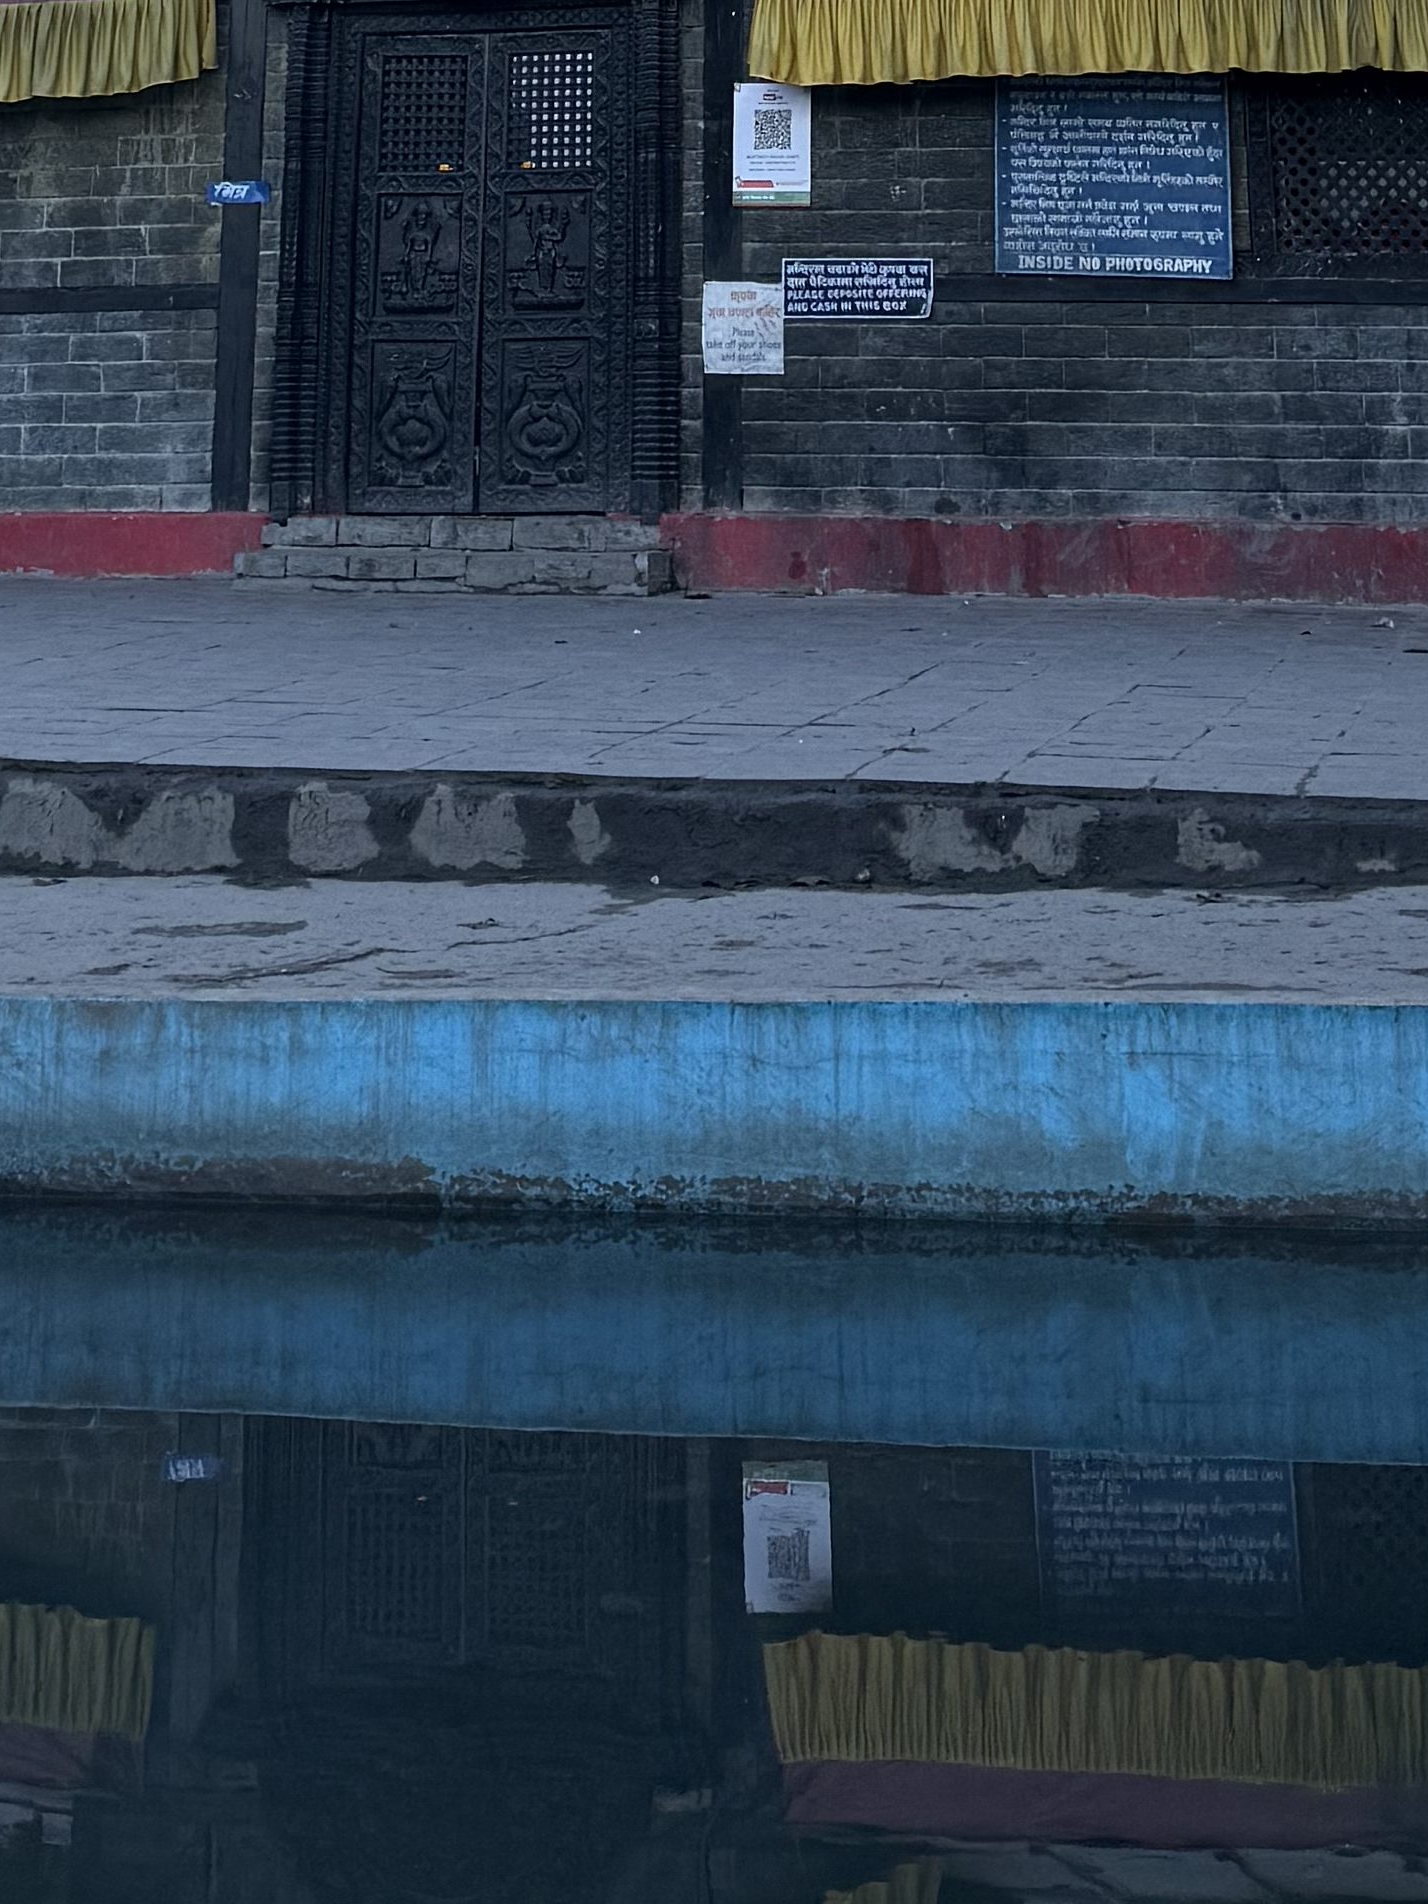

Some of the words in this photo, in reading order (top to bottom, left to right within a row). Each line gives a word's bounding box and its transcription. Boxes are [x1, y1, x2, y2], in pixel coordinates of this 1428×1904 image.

[1111, 129, 1135, 143] दर्शन
[1018, 255, 1074, 270] INSIDE
[1079, 256, 1101, 270] NO
[1105, 257, 1212, 274] PHOTOGRAPHY
[787, 290, 825, 300] PLEASE
[827, 289, 874, 299] DEPOSITE
[876, 288, 927, 299] OFFERING
[787, 302, 809, 312] AND
[810, 301, 838, 312] CASH
[840, 301, 852, 311] IN
[855, 300, 880, 311] THIS
[882, 300, 907, 311] BOX
[732, 326, 755, 337] Please
[706, 339, 723, 349] take
[724, 339, 736, 349] off
[737, 342, 756, 351] your
[759, 340, 782, 349] shoes
[721, 352, 736, 361] and
[738, 352, 767, 362] sandals
